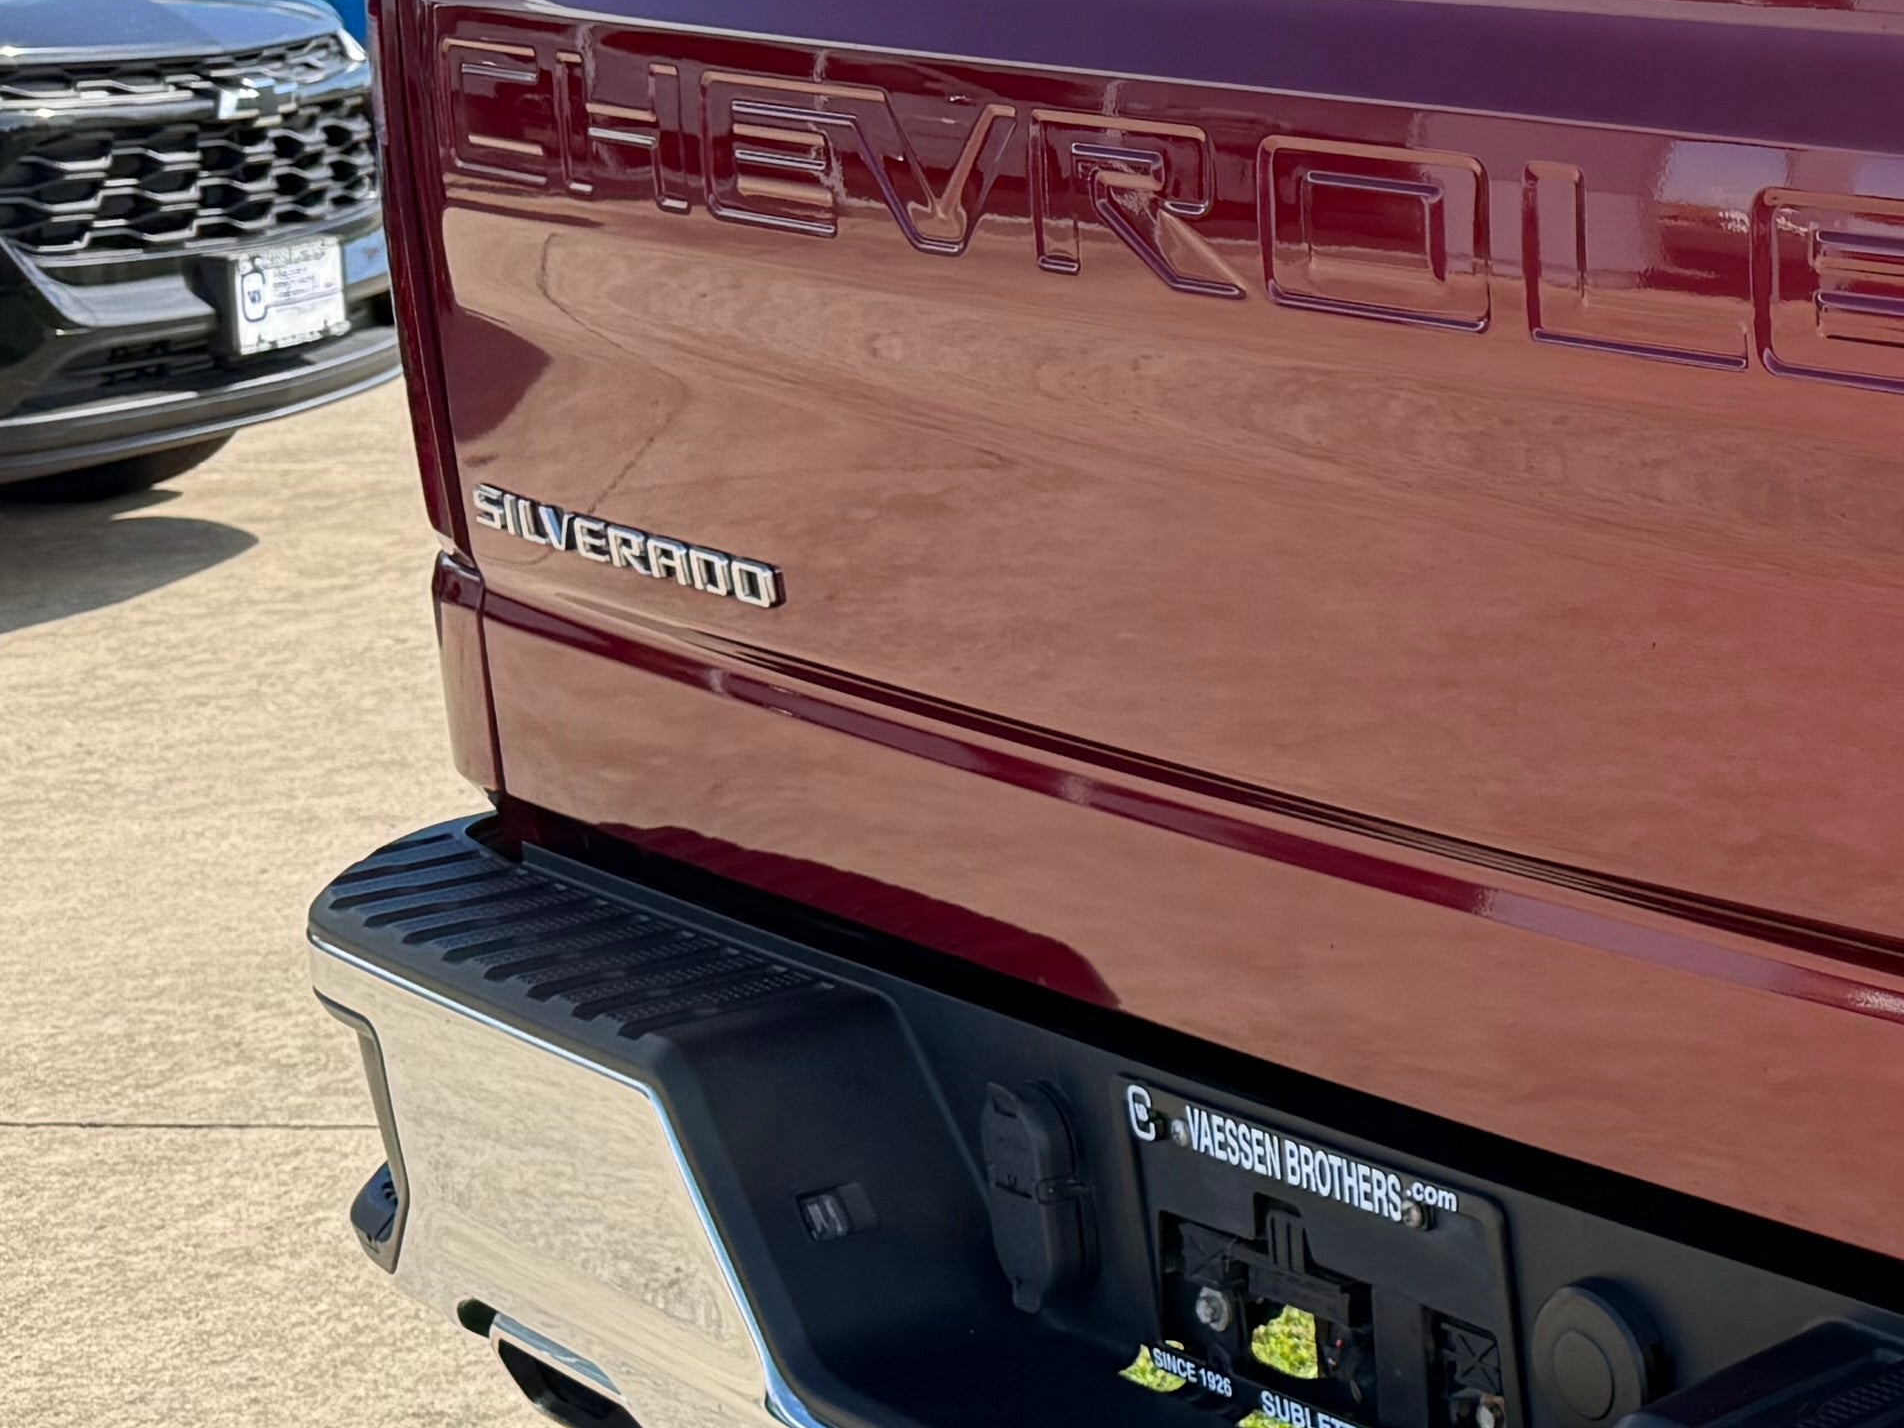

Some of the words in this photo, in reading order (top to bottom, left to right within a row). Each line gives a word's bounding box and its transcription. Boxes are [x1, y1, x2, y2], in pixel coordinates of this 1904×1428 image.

[473, 482, 782, 608] SILVERADO
[1185, 1104, 1282, 1179] VAESSEN
[1284, 1139, 1403, 1222] BROTHERS
[1152, 1346, 1198, 1384] SINCE
[1199, 1367, 1233, 1398] 1926
